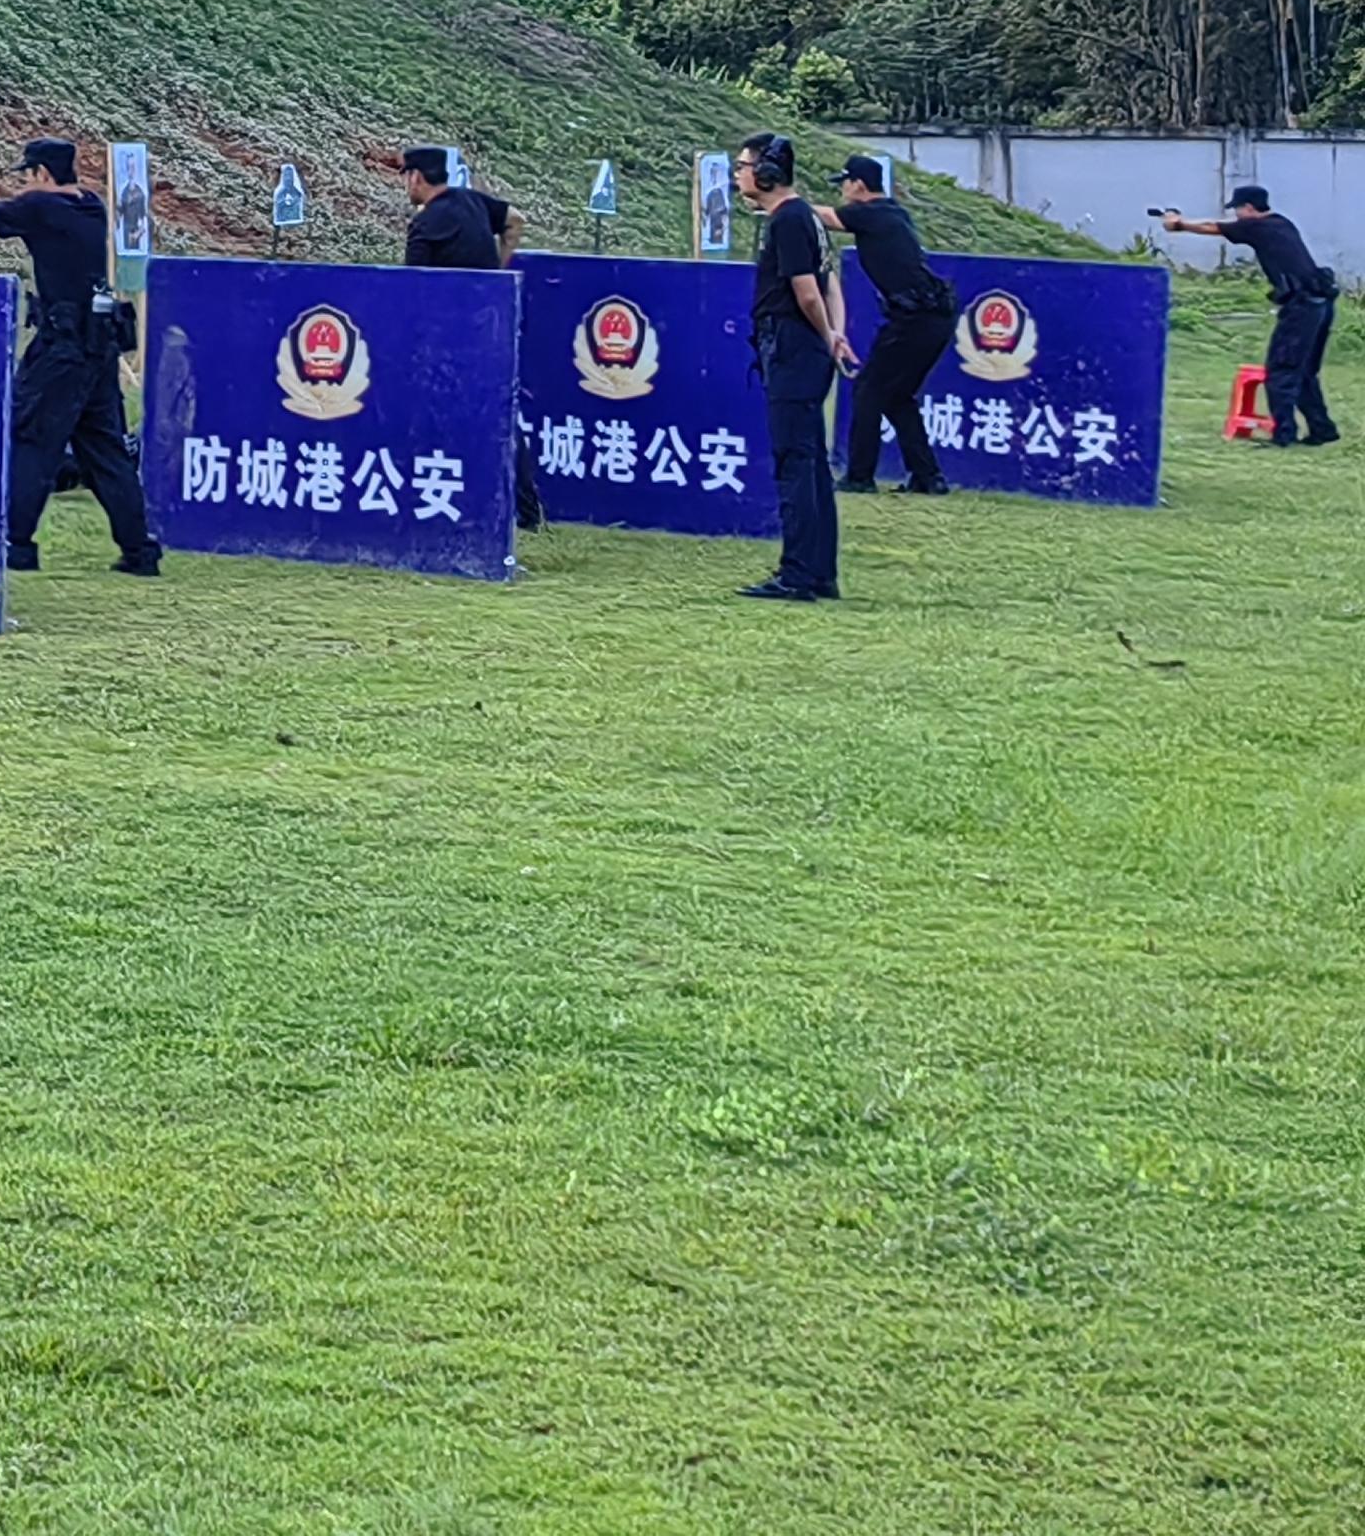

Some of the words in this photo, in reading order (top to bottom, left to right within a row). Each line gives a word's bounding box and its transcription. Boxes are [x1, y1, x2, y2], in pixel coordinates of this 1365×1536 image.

[183, 435, 465, 522] 防城港公安
